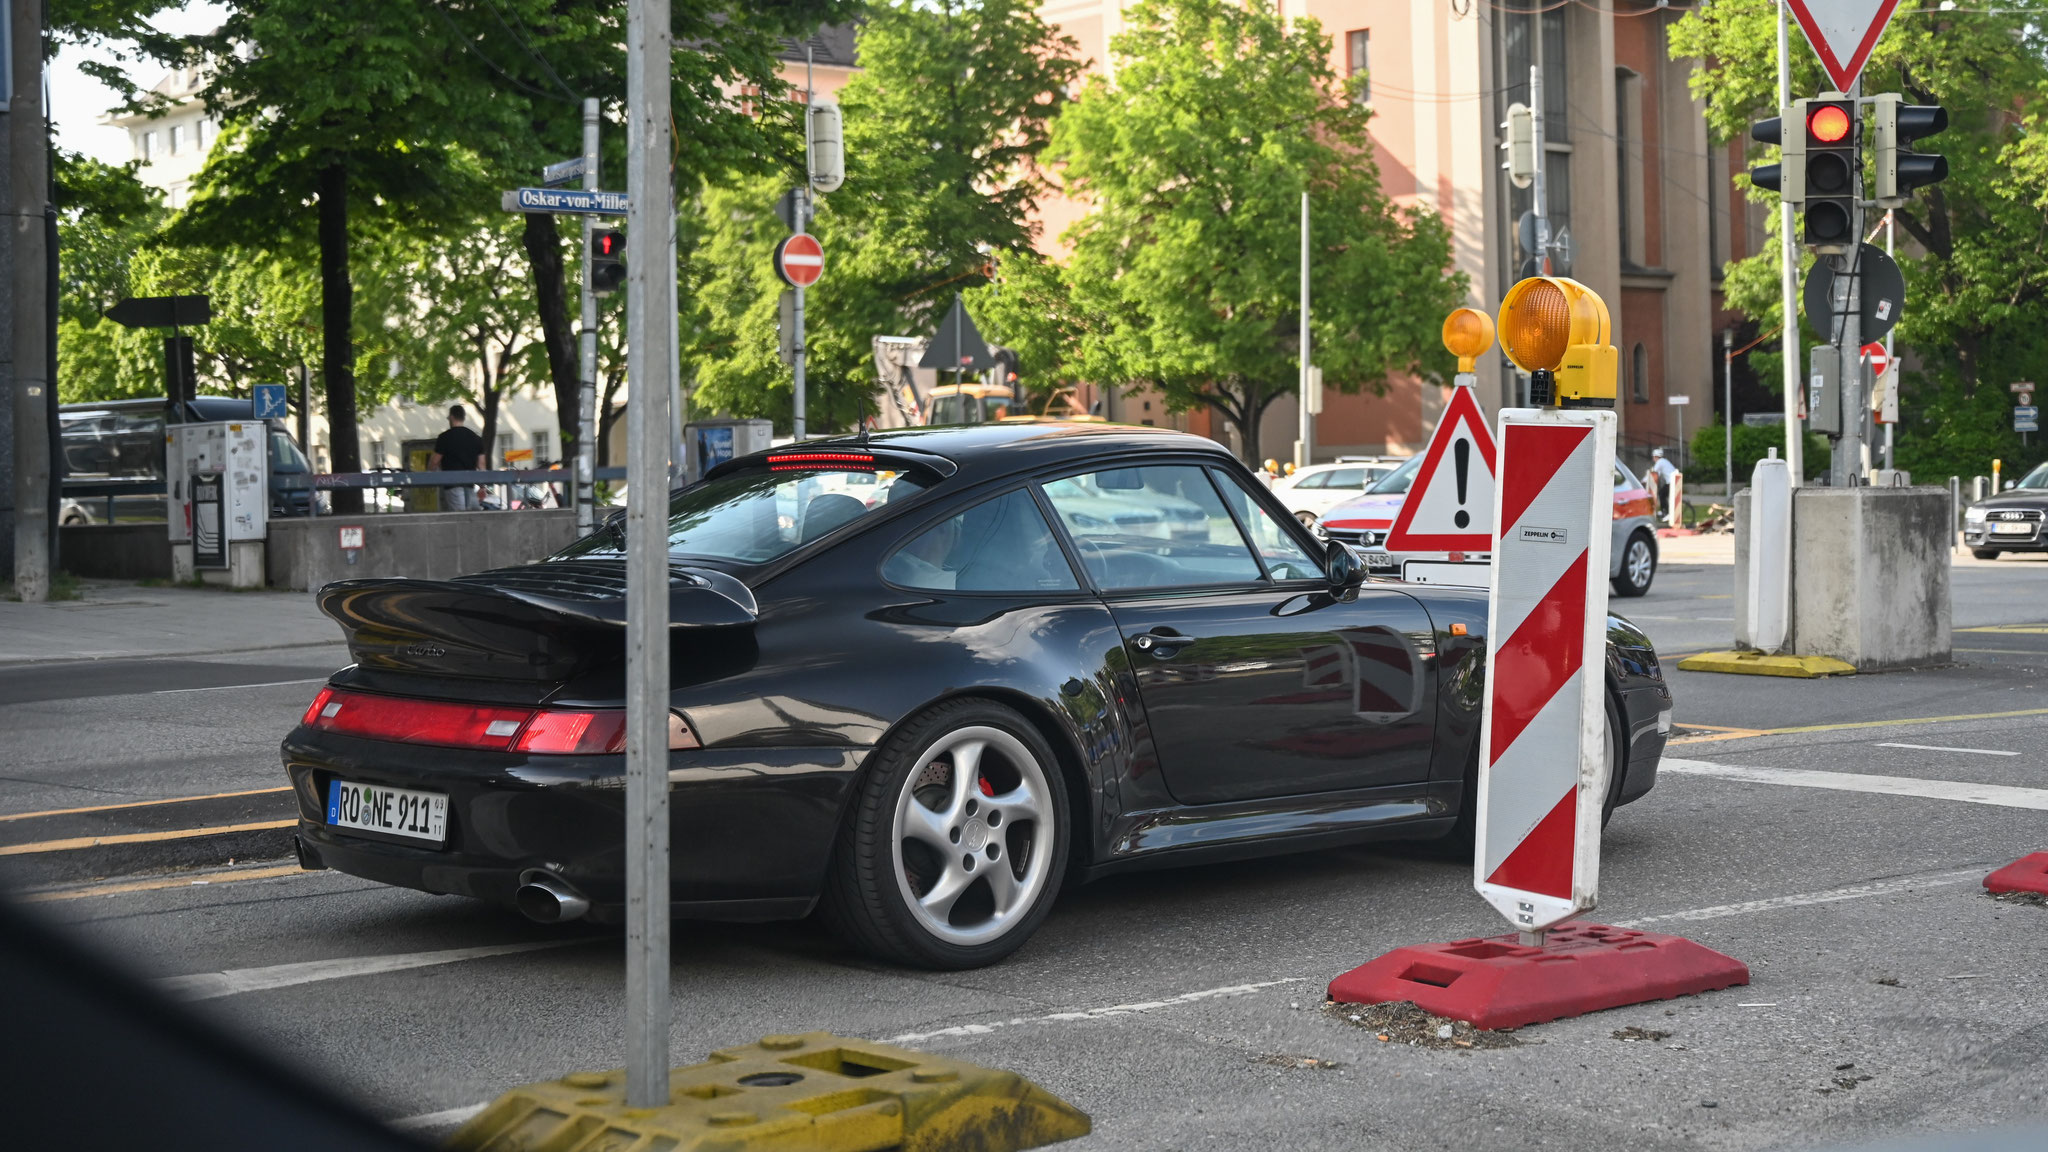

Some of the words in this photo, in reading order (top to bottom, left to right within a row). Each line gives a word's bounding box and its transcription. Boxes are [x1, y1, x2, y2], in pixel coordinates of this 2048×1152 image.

[1368, 555, 1391, 565] 8490
[407, 643, 446, 657] turbo
[331, 807, 336, 818] D
[338, 786, 361, 823] RO
[372, 790, 395, 828] NE
[398, 794, 431, 834] 911
